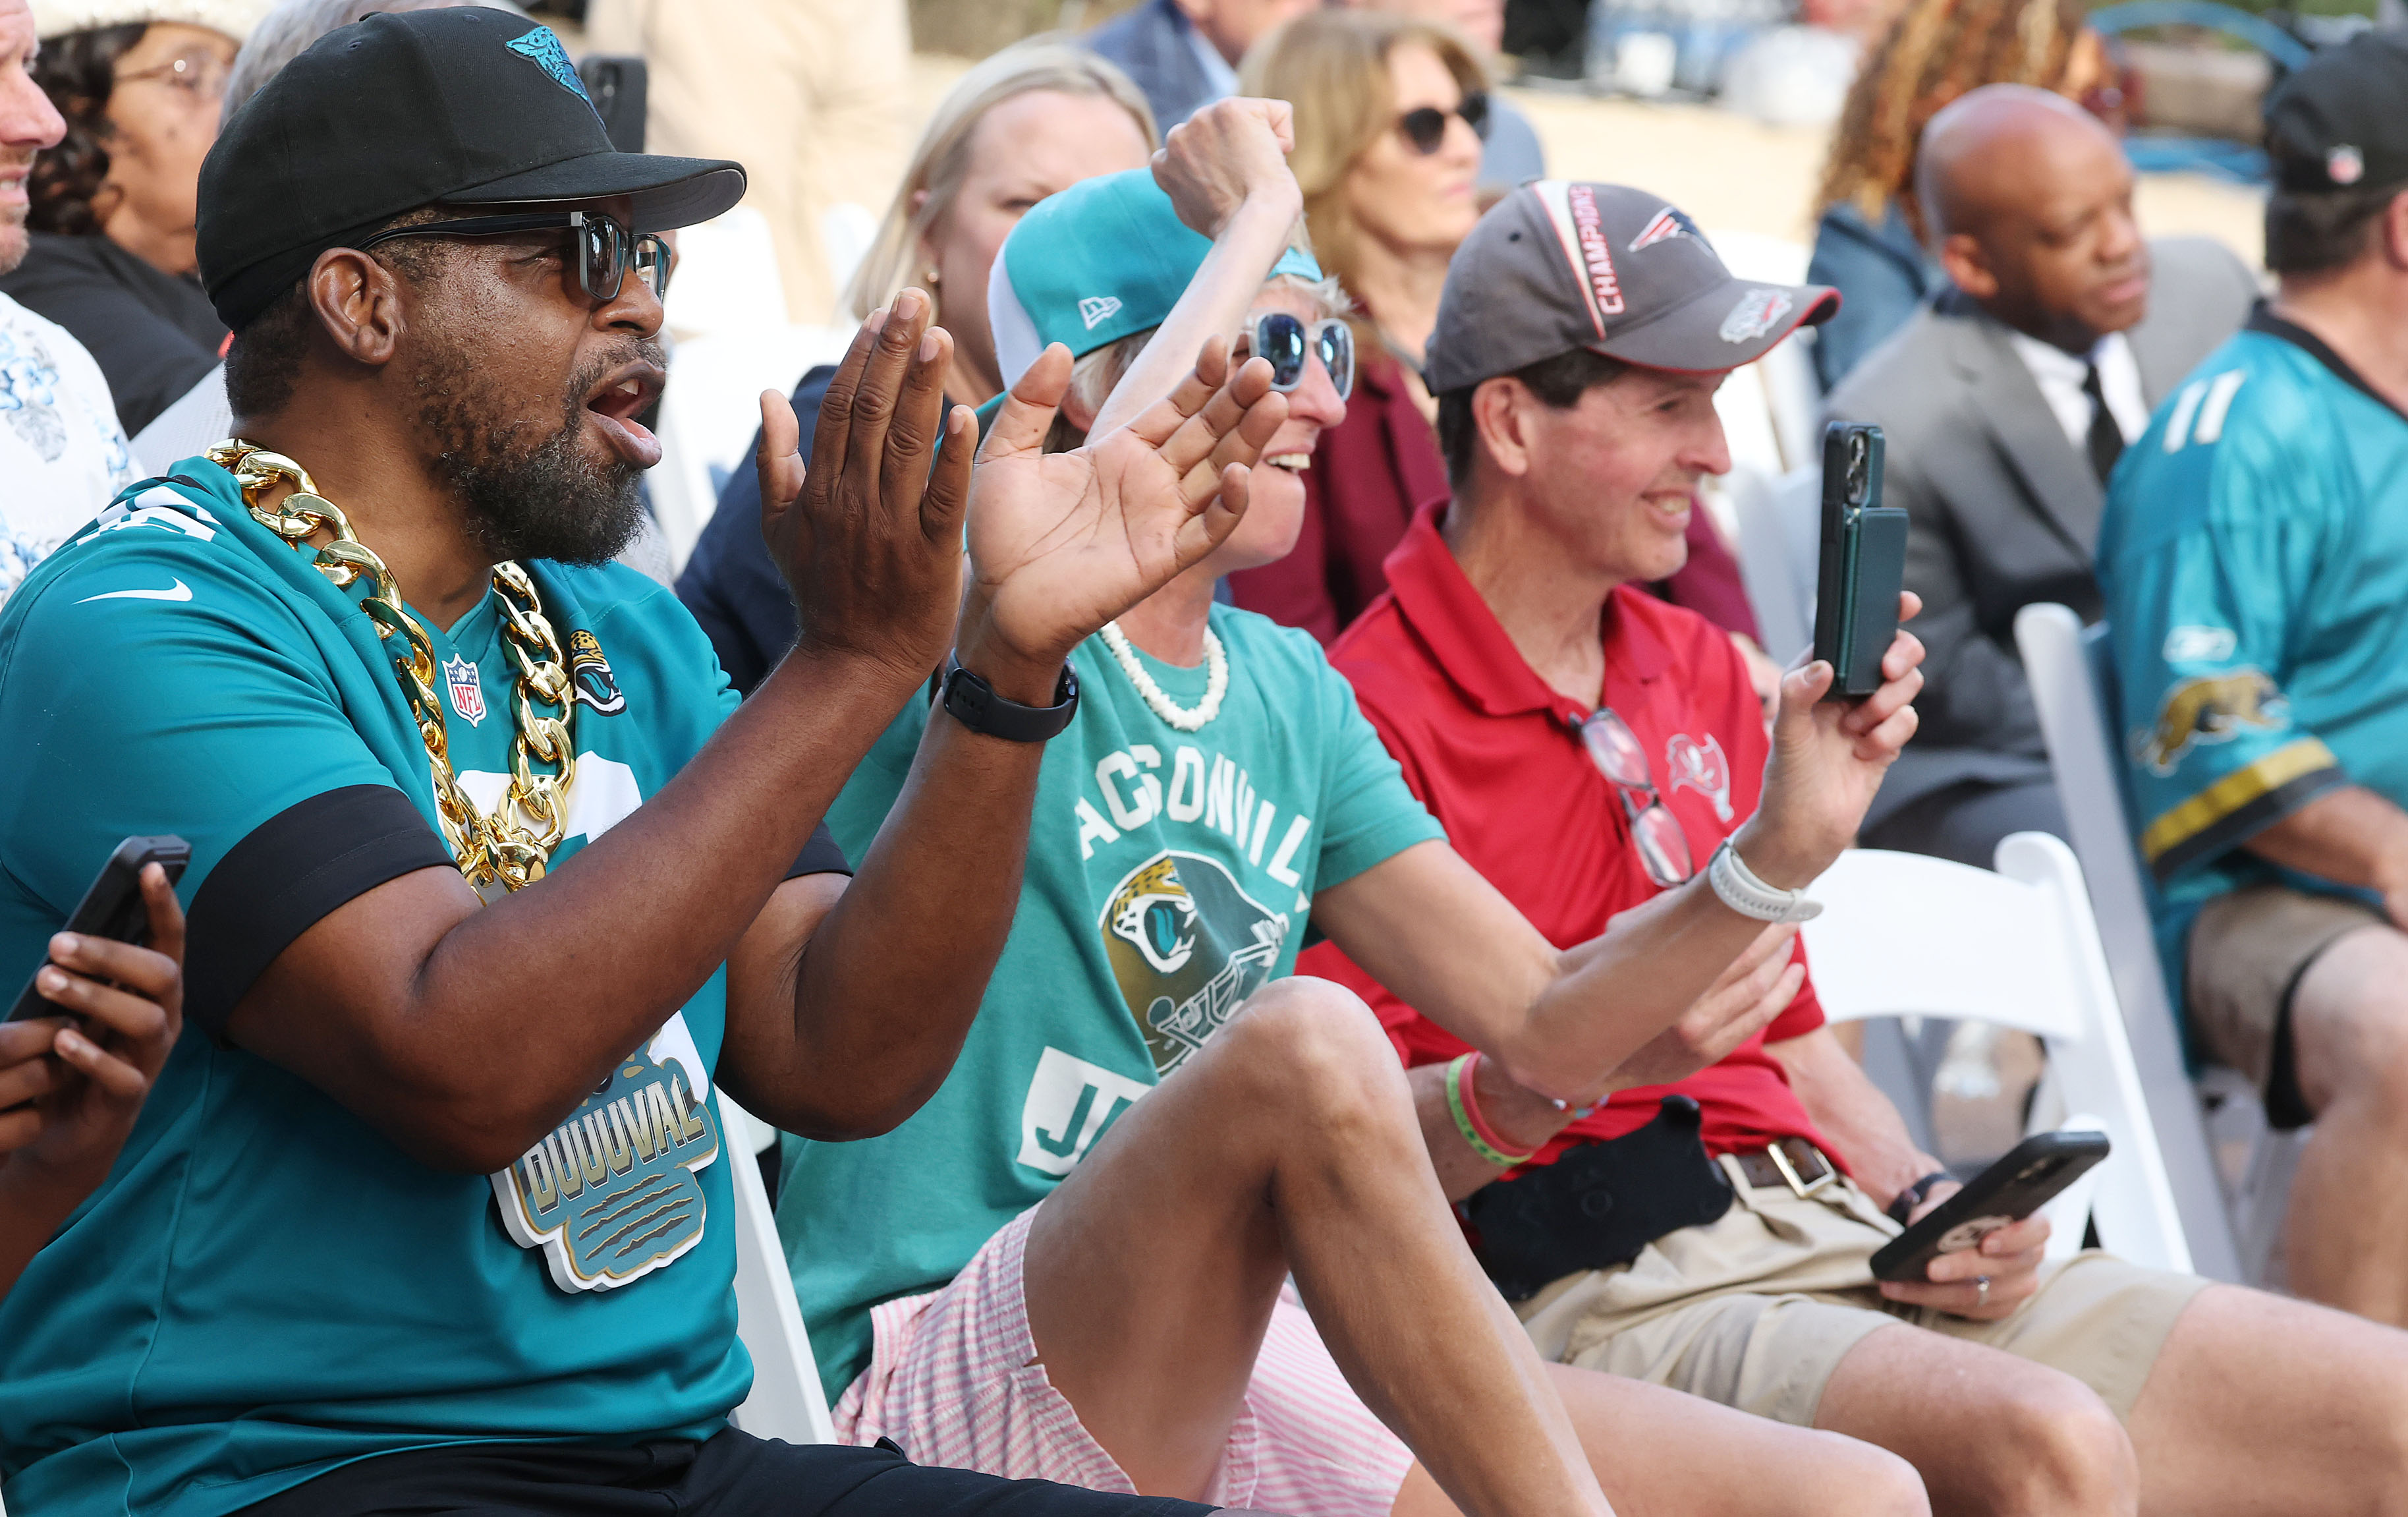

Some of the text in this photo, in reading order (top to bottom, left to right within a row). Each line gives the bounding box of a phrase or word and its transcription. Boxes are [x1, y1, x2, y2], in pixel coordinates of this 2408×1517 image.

[1568, 185, 1625, 315] CHAMPIONS
[2162, 368, 2247, 453] 11
[455, 685, 481, 714] NFL
[522, 1073, 706, 1215] DUUUVAL
